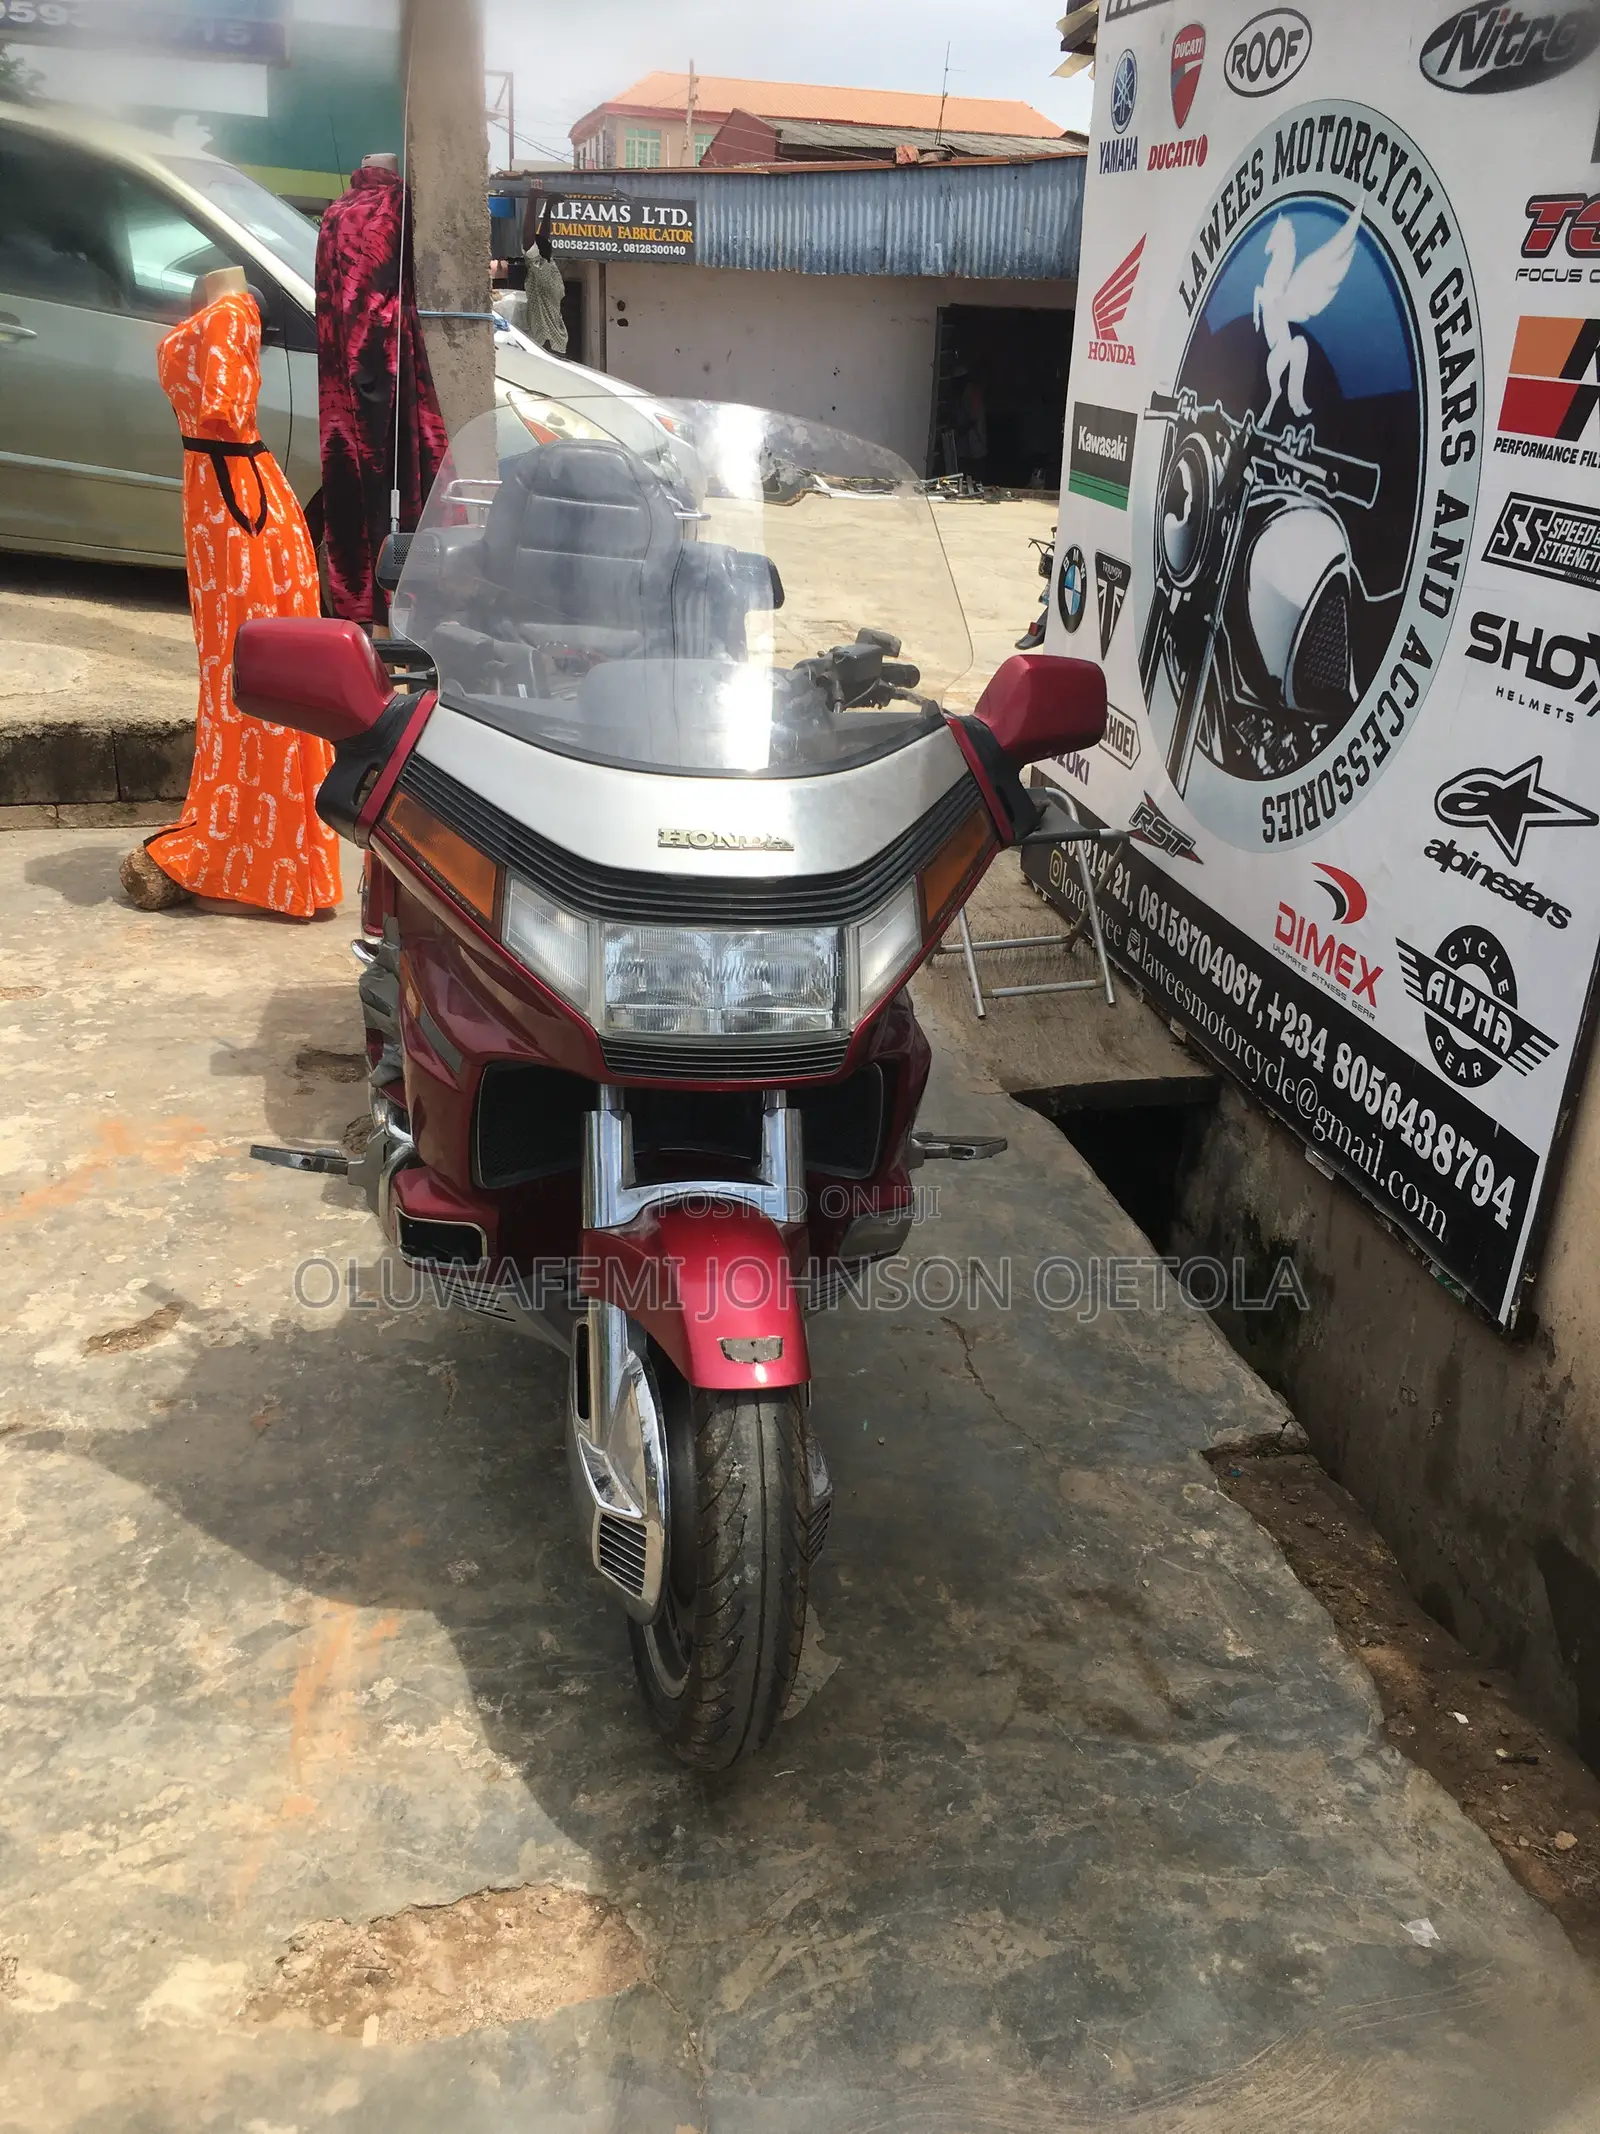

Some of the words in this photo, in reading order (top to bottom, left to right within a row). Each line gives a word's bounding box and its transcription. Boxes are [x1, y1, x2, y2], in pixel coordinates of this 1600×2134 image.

[1231, 26, 1304, 83] ROOF
[1099, 136, 1138, 175] YAMAHA
[1147, 138, 1198, 171] DUCATI
[642, 206, 693, 227] LTD.
[1272, 114, 1451, 278] MOTORCYCLE
[617, 226, 694, 244] FABRICATOR
[623, 243, 686, 255] 08128300140
[1179, 148, 1263, 317] LAWEES
[1515, 268, 1583, 283] FOCUS
[1088, 341, 1136, 365] HONDA
[1429, 267, 1477, 467] GEARS
[1078, 425, 1128, 462] Kawasaki
[1493, 437, 1579, 465] PERFORMANCE
[1419, 489, 1470, 619] AND
[1548, 518, 1597, 546] SPEED
[1496, 686, 1574, 724] HELMETS
[1262, 625, 1434, 844] ACCESSORIES
[657, 828, 795, 851] HONDA
[1129, 801, 1196, 858] RST
[1423, 839, 1572, 929] alpinestars
[1272, 943, 1308, 973] ULTIMATE
[1312, 971, 1347, 1001] FITNESS
[1351, 1000, 1376, 1021] GEAR
[1274, 901, 1384, 1008] DIMEX
[1448, 938, 1510, 995] CYCLE
[1426, 970, 1513, 1054] ALPHA
[1434, 1035, 1482, 1078] GEAR
[1141, 937, 1447, 1243] laweesmotorcycle@gmail.com
[1332, 1043, 1516, 1230] 8056438794
